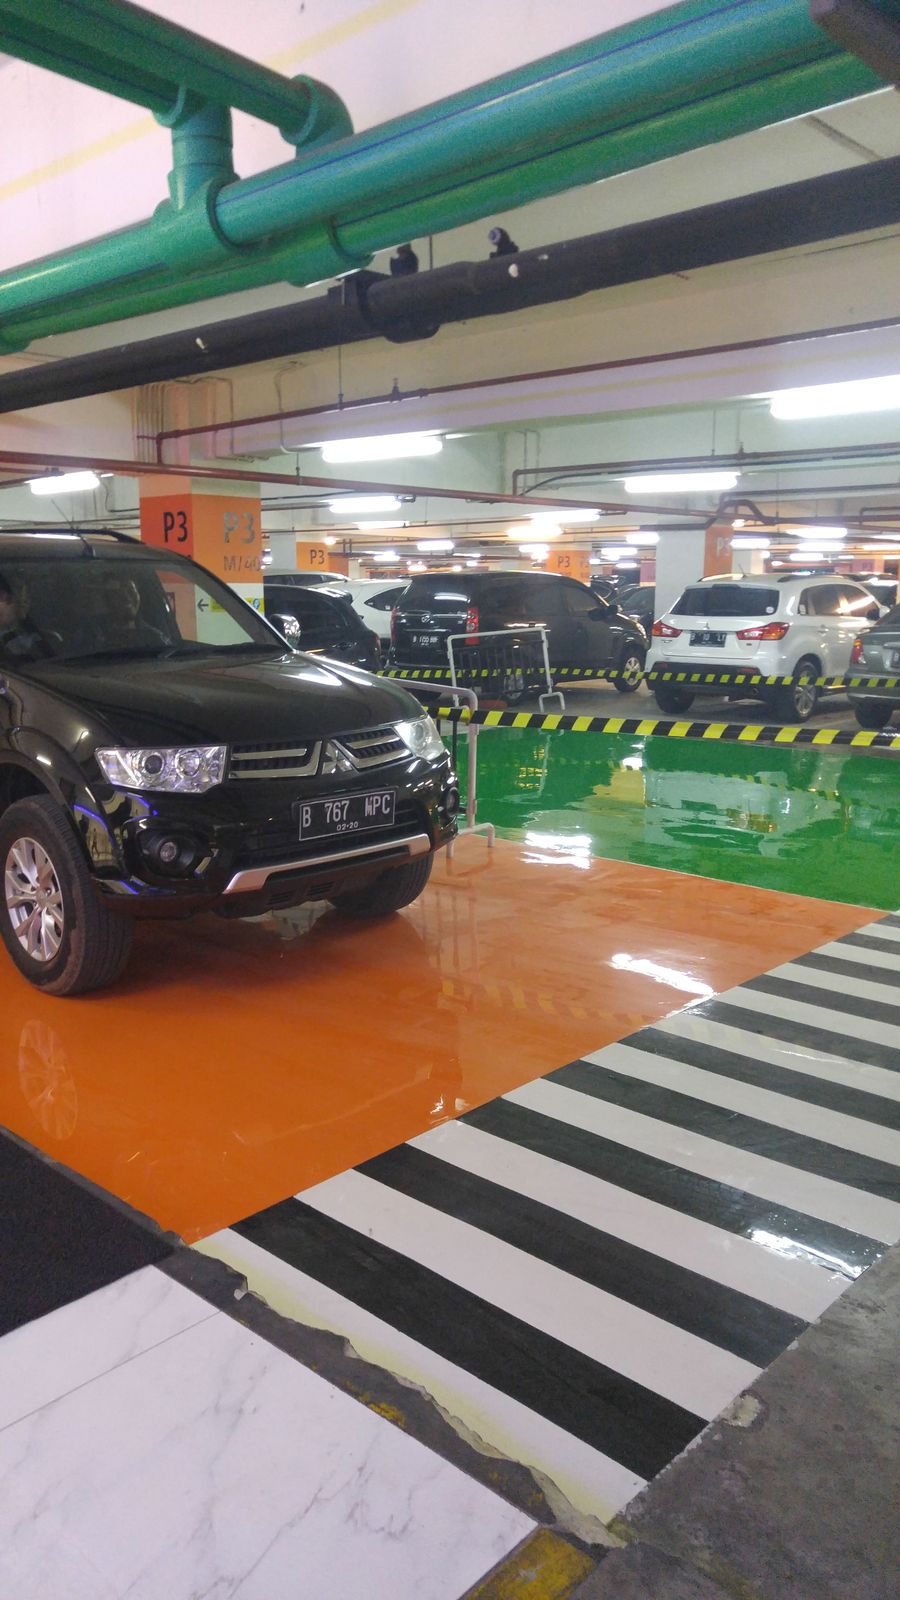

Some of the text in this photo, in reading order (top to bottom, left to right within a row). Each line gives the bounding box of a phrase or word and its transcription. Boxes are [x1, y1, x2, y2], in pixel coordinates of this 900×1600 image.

[163, 511, 188, 543] P3
[224, 511, 255, 544] P3
[309, 549, 325, 564] P3
[558, 556, 570, 568] P3
[302, 806, 312, 828] B
[324, 800, 350, 823] 767
